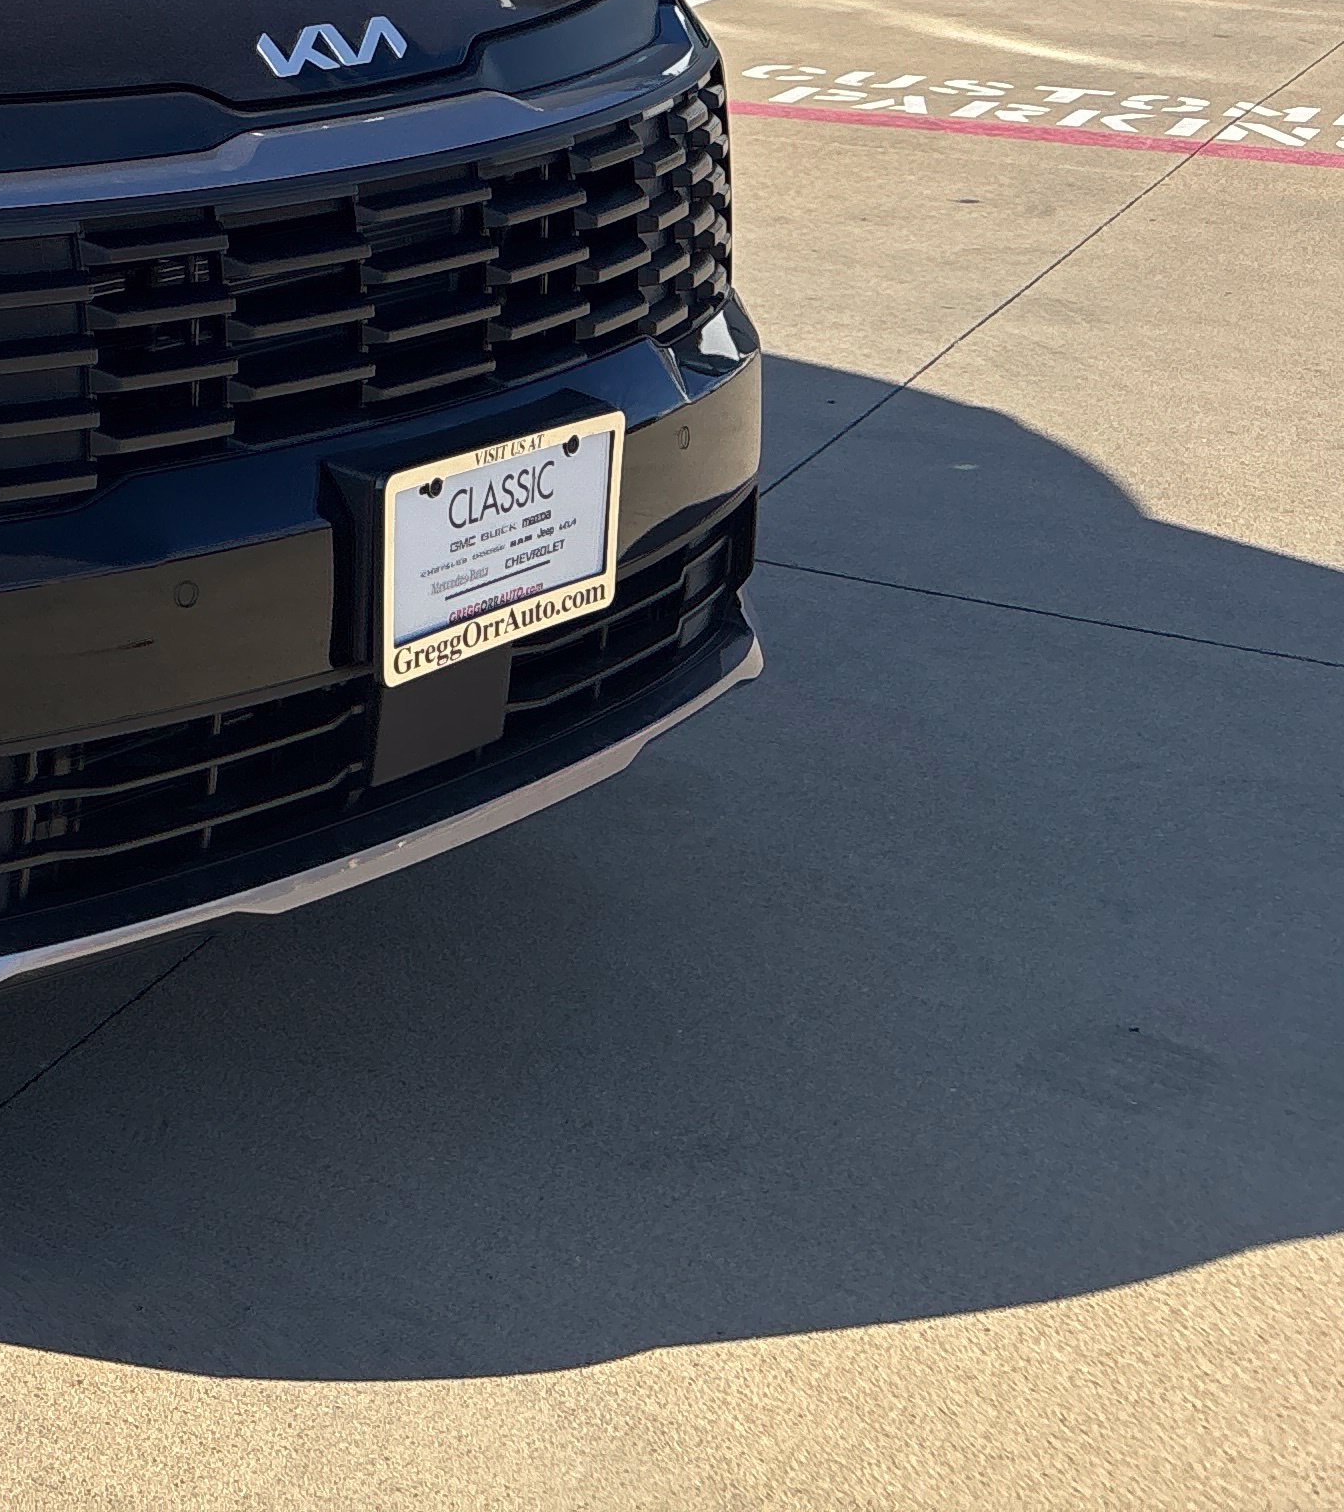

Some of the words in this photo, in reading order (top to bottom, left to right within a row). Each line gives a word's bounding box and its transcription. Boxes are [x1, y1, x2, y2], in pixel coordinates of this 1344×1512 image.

[256, 16, 408, 78] KIA
[768, 86, 1344, 149] PARKIN
[474, 445, 507, 466] VISIT
[510, 441, 525, 456] US
[527, 433, 545, 451] AT
[448, 460, 555, 529] CLASSIC
[449, 535, 477, 553] GMC
[480, 521, 517, 542] BUICK
[536, 525, 555, 541] Jeep
[504, 539, 566, 570] CHEVROLET
[448, 582, 544, 624] GREGGORRAUTO.com
[393, 582, 607, 675] GreggOrrAuto.com
